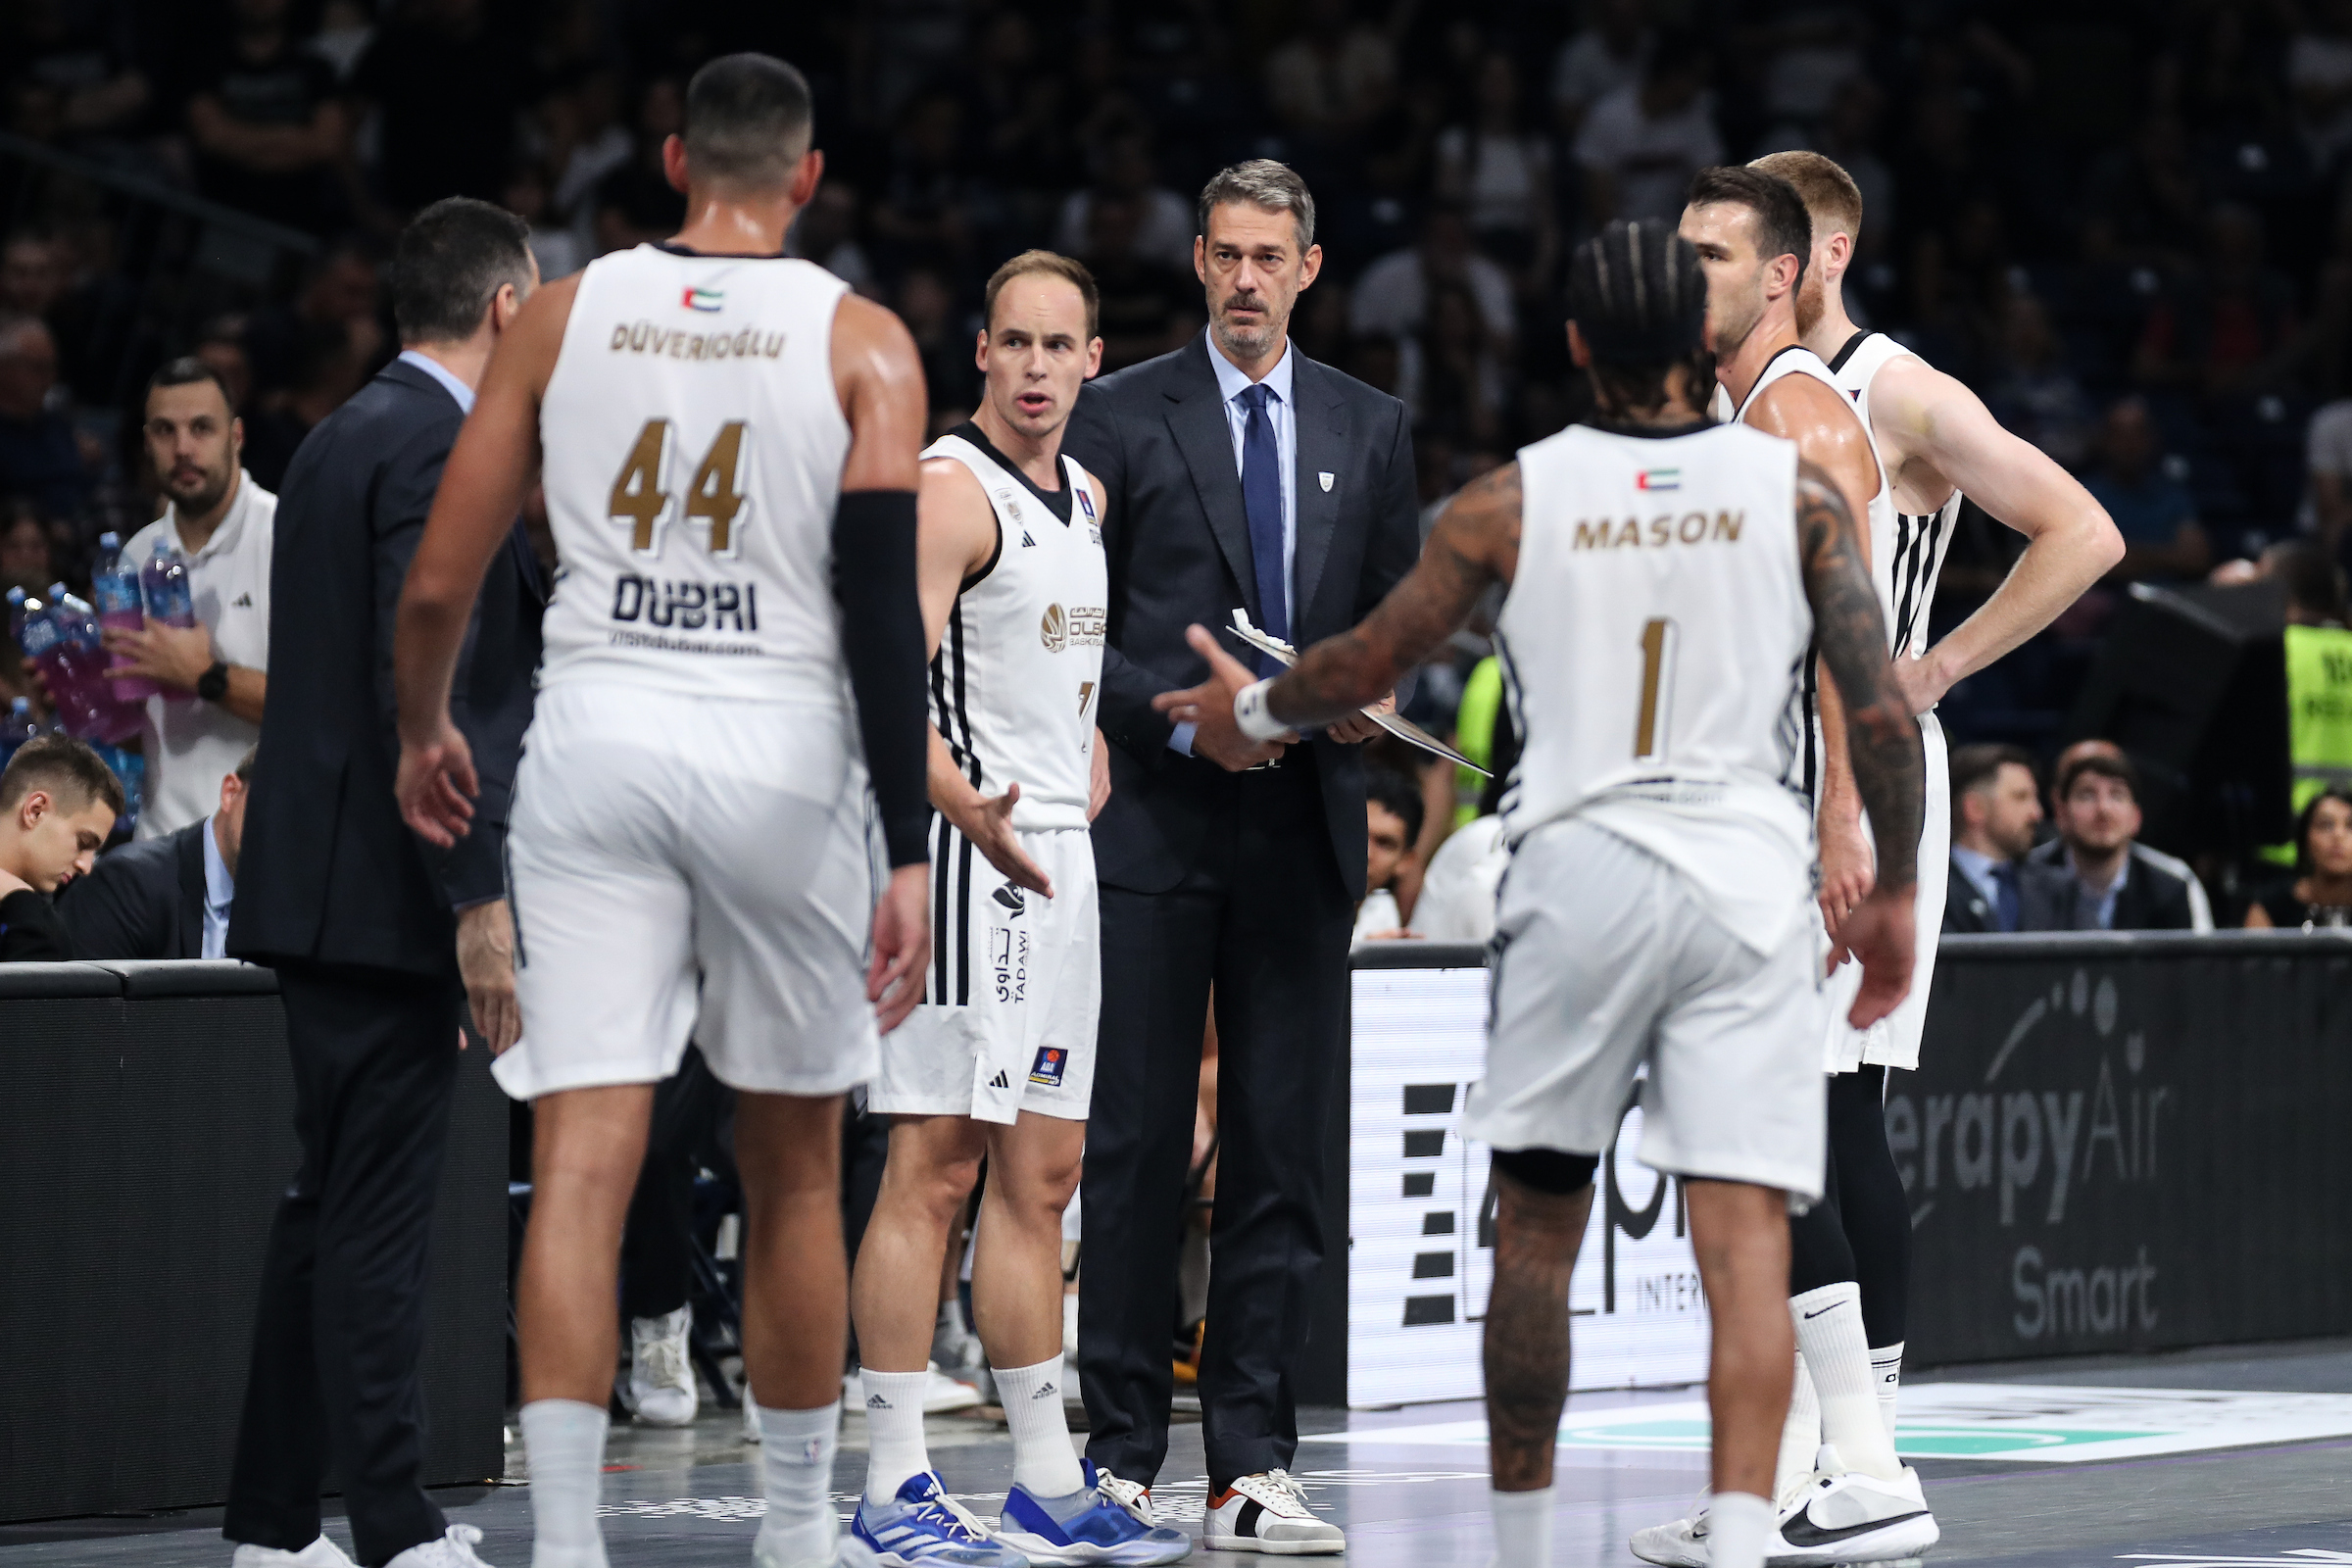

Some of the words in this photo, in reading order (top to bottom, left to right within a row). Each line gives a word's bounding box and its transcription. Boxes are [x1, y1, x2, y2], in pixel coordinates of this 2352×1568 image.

[608, 417, 748, 559] 44
[1572, 508, 1745, 550] MASON
[612, 574, 759, 631] DUBAI
[1634, 616, 1676, 761] 1
[1014, 930, 1026, 1004] TADAWI
[1884, 1053, 2169, 1225] erapyAir
[2014, 1246, 2157, 1339] Smart
